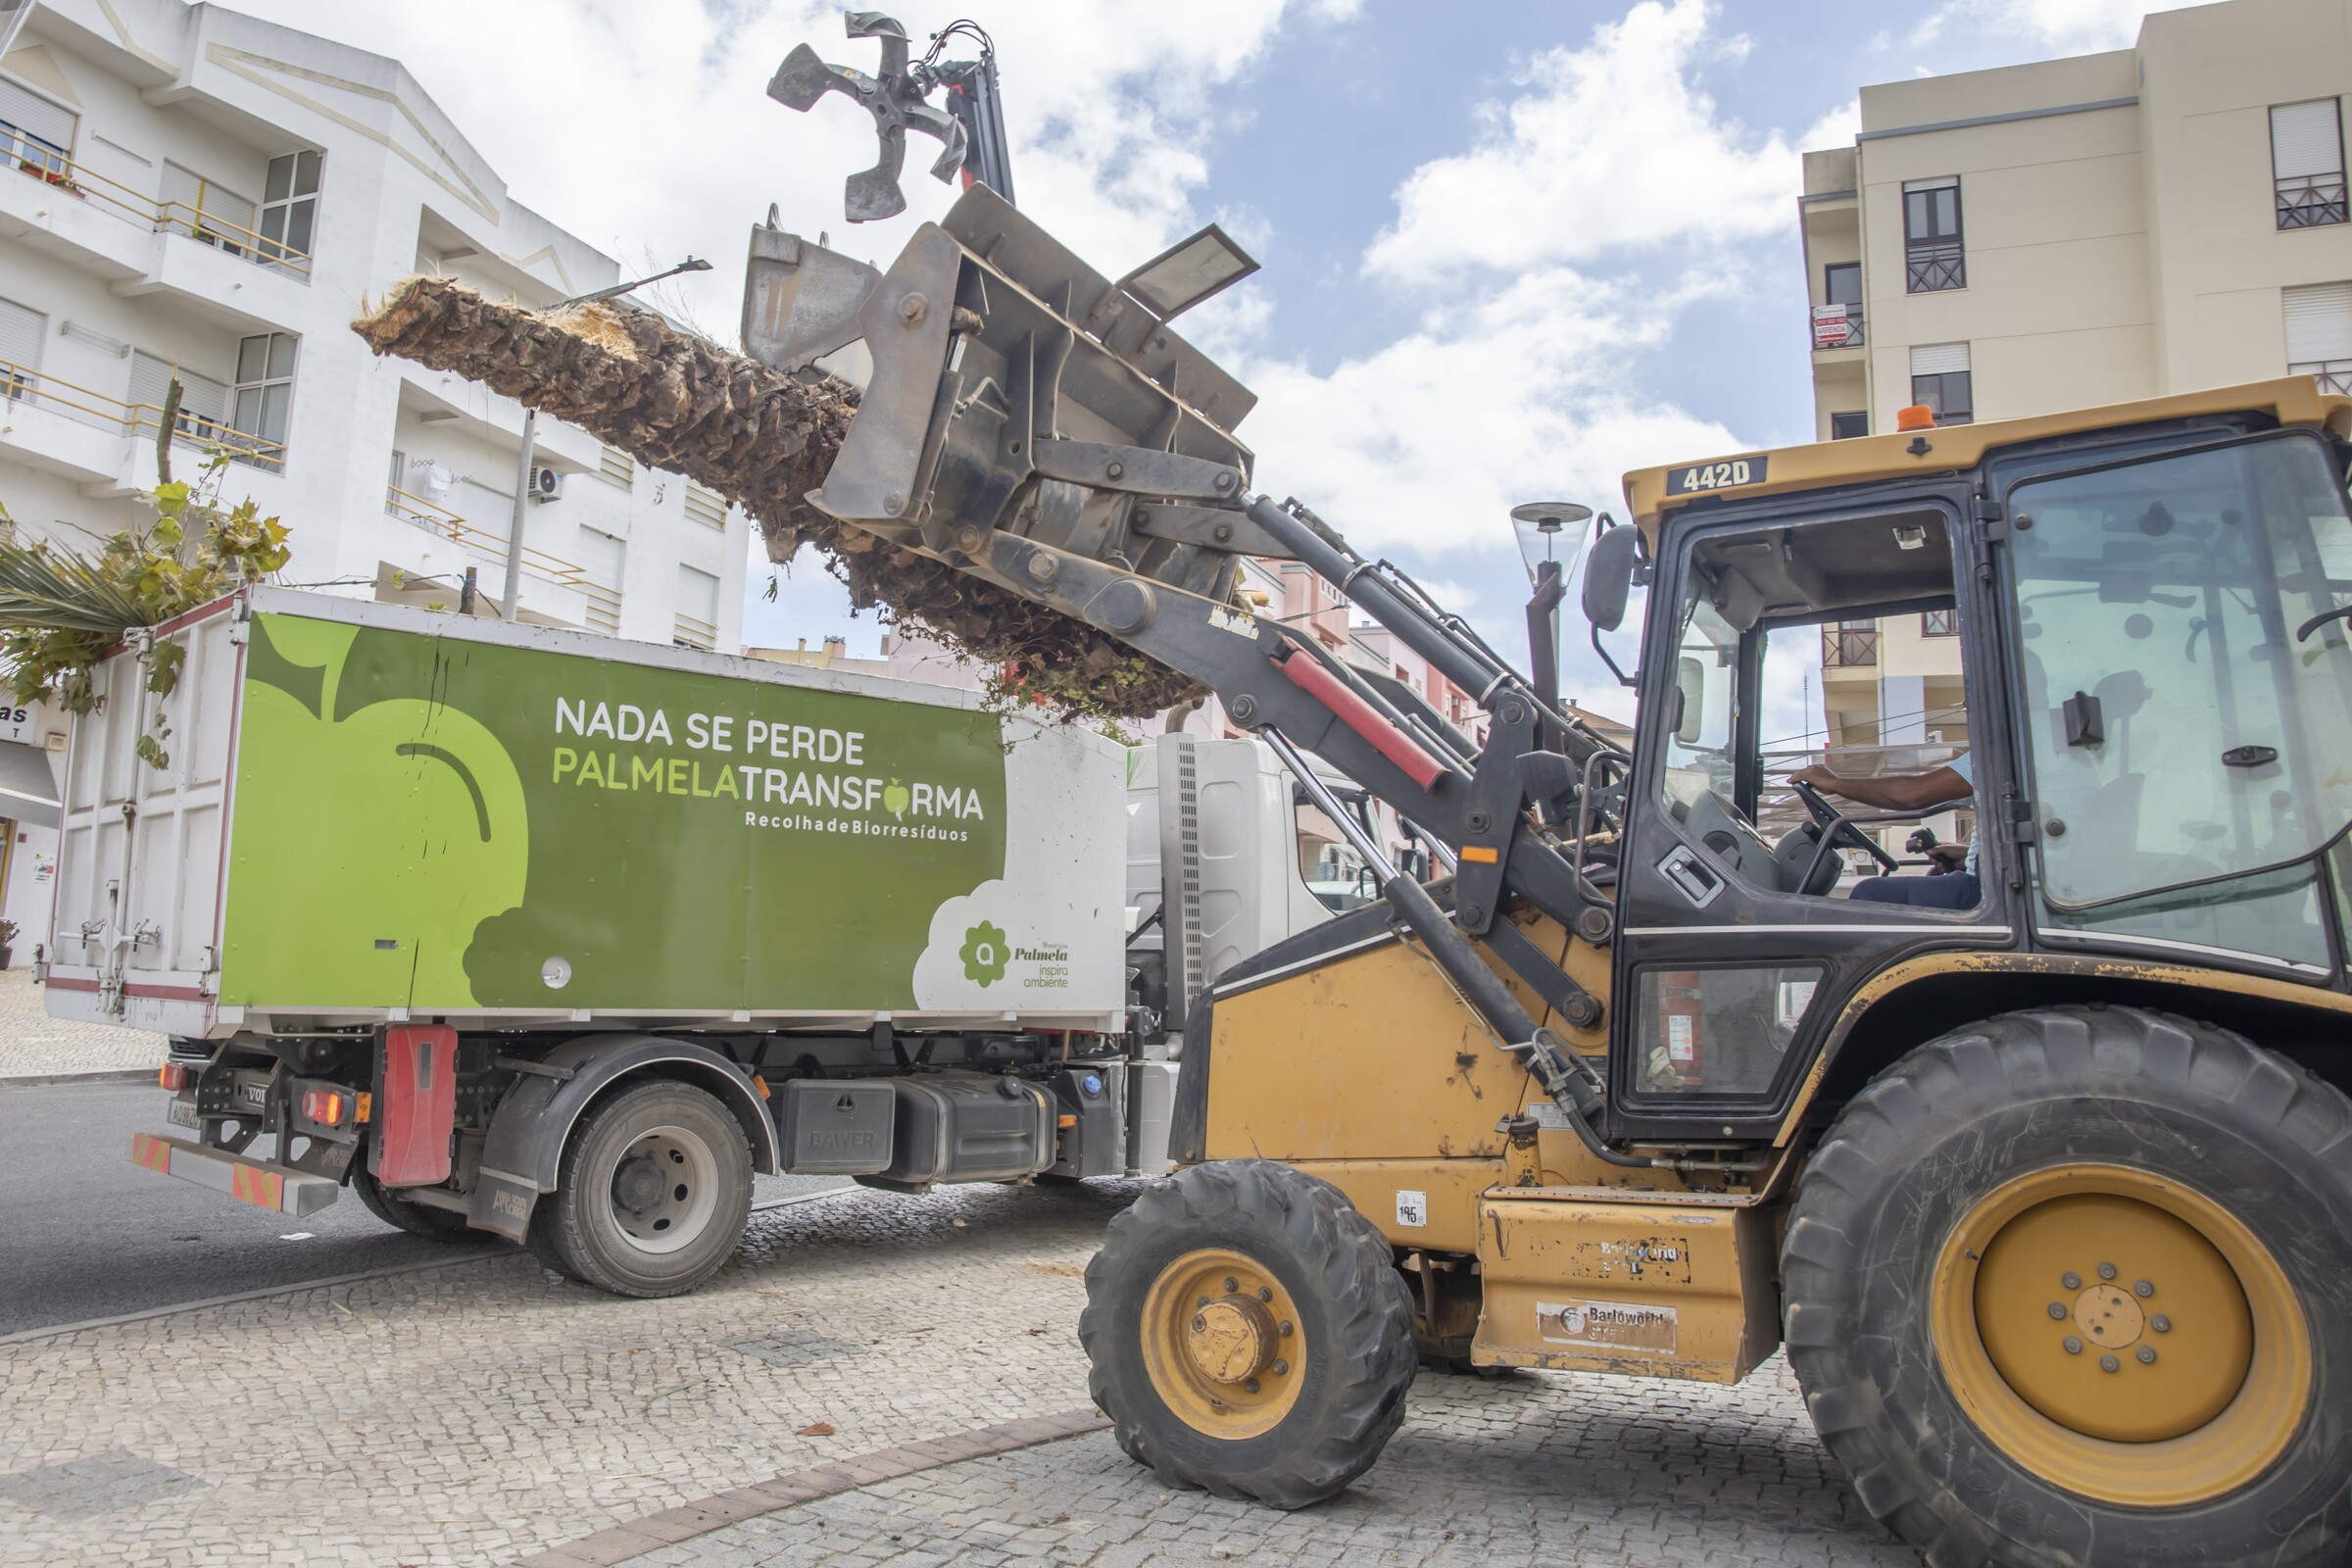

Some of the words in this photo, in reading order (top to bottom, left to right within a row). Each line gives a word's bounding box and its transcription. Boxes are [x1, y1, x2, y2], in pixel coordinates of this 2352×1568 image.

[1684, 461, 1749, 491] 442D
[556, 697, 673, 746] NADA
[686, 713, 733, 752] SE
[747, 719, 864, 765] PERDE
[1014, 948, 1067, 961] Palmela
[1039, 964, 1068, 978] inspira
[1024, 976, 1068, 988] ambiente
